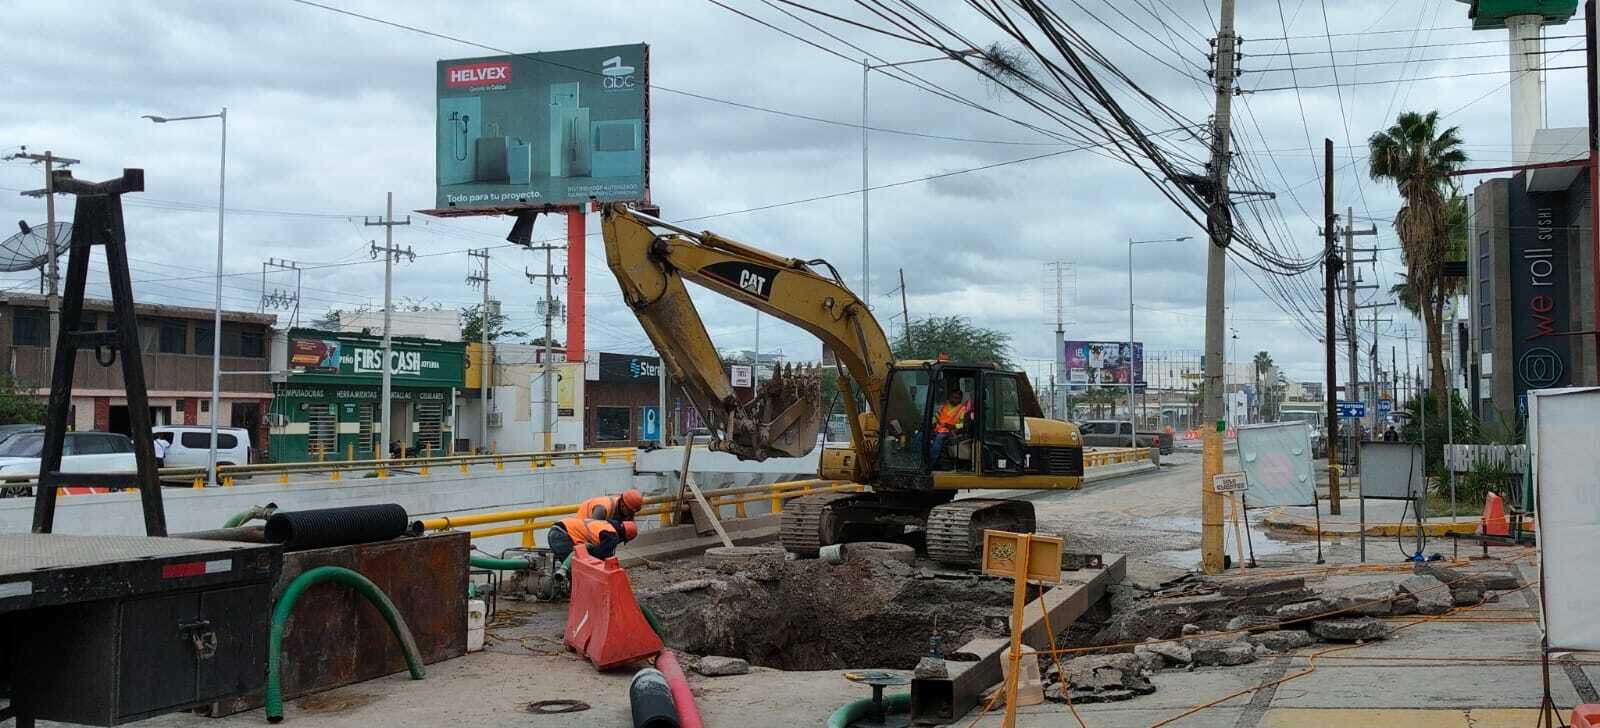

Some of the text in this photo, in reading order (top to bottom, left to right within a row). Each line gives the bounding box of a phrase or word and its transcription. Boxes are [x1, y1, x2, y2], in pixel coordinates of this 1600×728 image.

[451, 66, 506, 82] HELVEX
[603, 74, 635, 89] abc
[447, 193, 468, 202] Todo
[469, 194, 489, 204] para
[501, 191, 543, 201] proyecto.
[740, 269, 766, 296] CAT
[1523, 208, 1553, 340] we roll SUSHI
[390, 351, 420, 375] CASH
